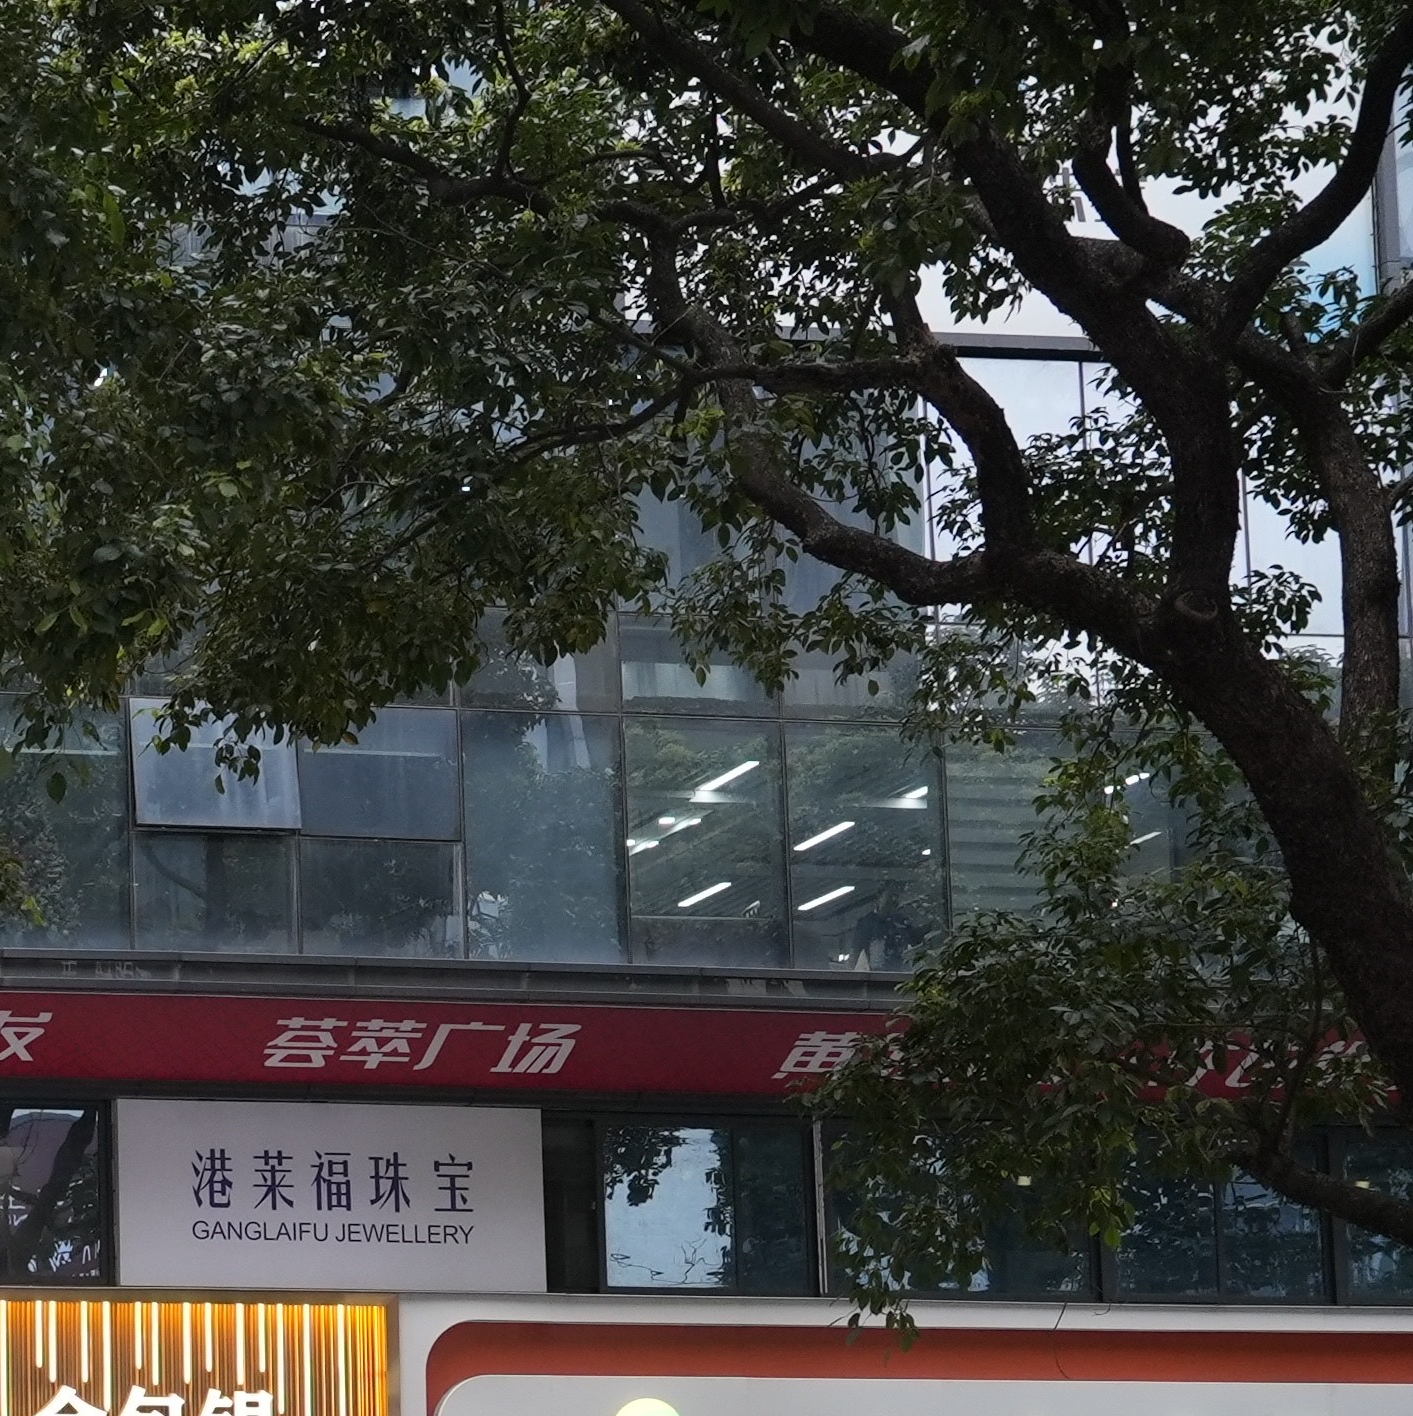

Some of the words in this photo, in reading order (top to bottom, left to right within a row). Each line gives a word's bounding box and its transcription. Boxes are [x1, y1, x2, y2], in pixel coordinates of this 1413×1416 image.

[263, 1017, 582, 1075] 荟萃广场
[191, 1148, 475, 1213] 港莱福珠宝
[192, 1220, 328, 1242] GANGLAIFU
[335, 1223, 474, 1244] JEWELLERY
